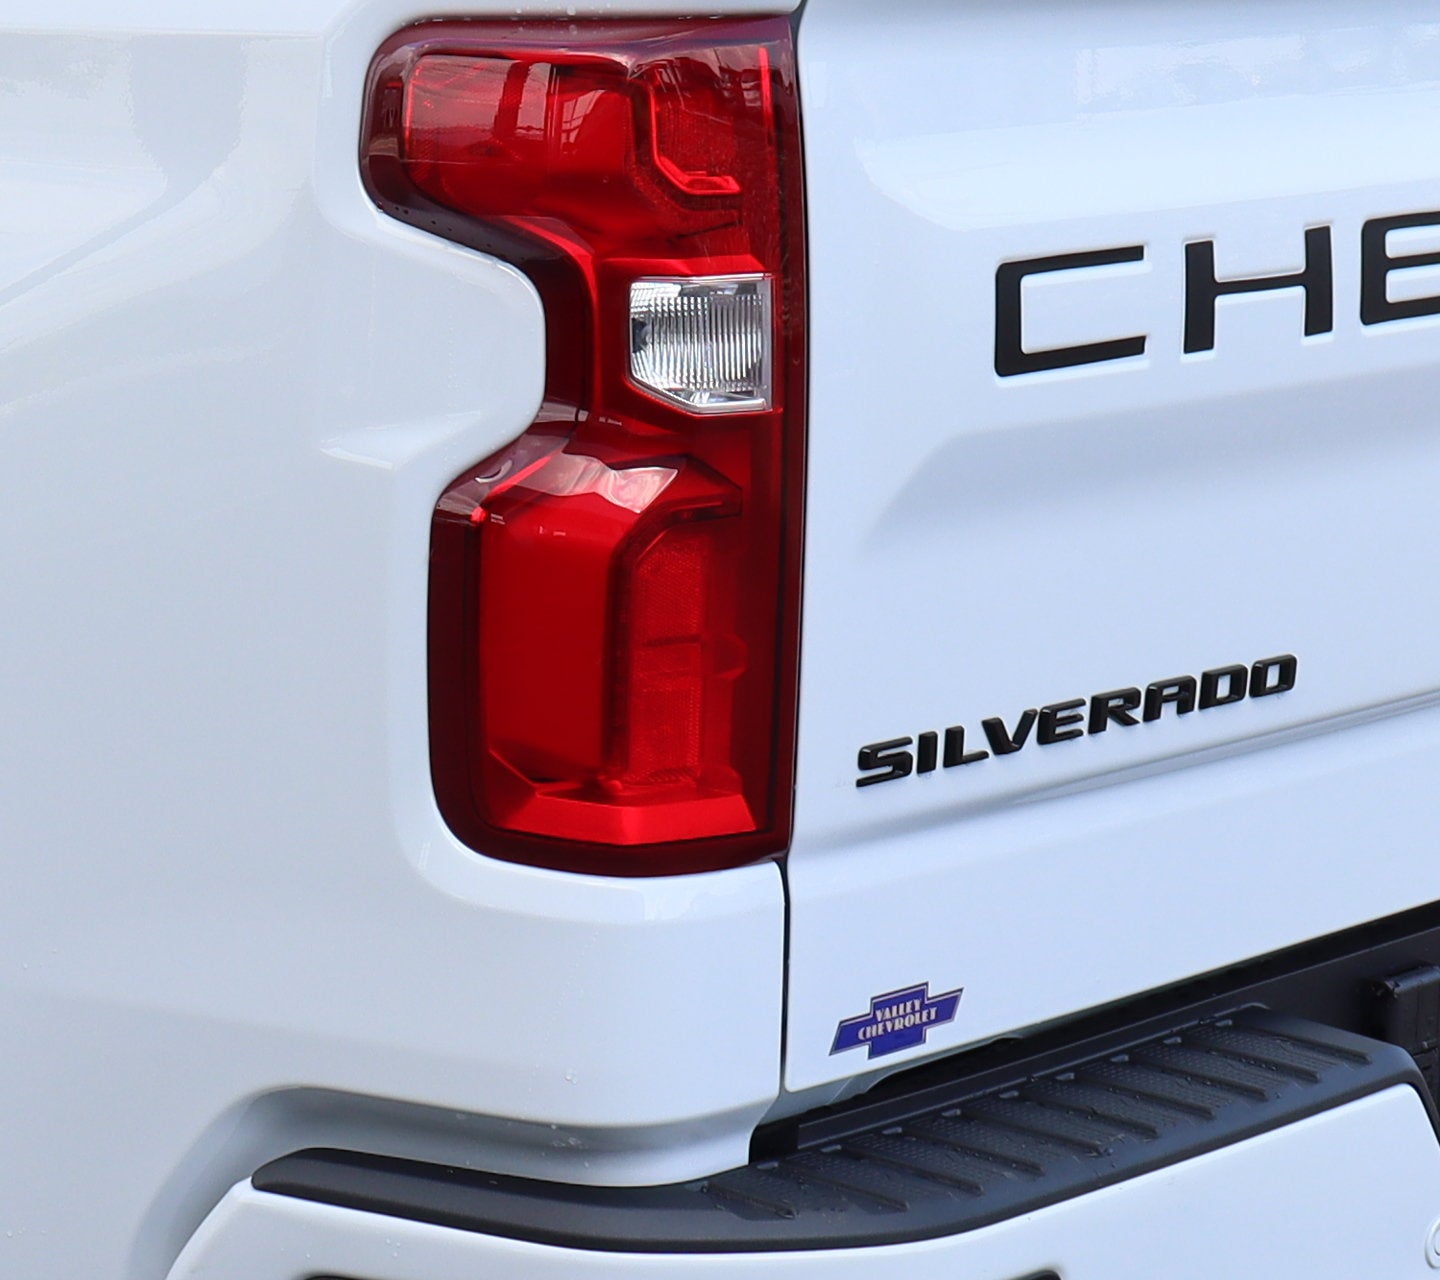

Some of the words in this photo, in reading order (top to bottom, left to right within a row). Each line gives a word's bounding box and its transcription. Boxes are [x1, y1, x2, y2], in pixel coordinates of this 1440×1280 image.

[854, 653, 1298, 788] SILVERADO
[857, 1007, 937, 1041] CHEVROLET
[875, 998, 921, 1022] VALLEY
